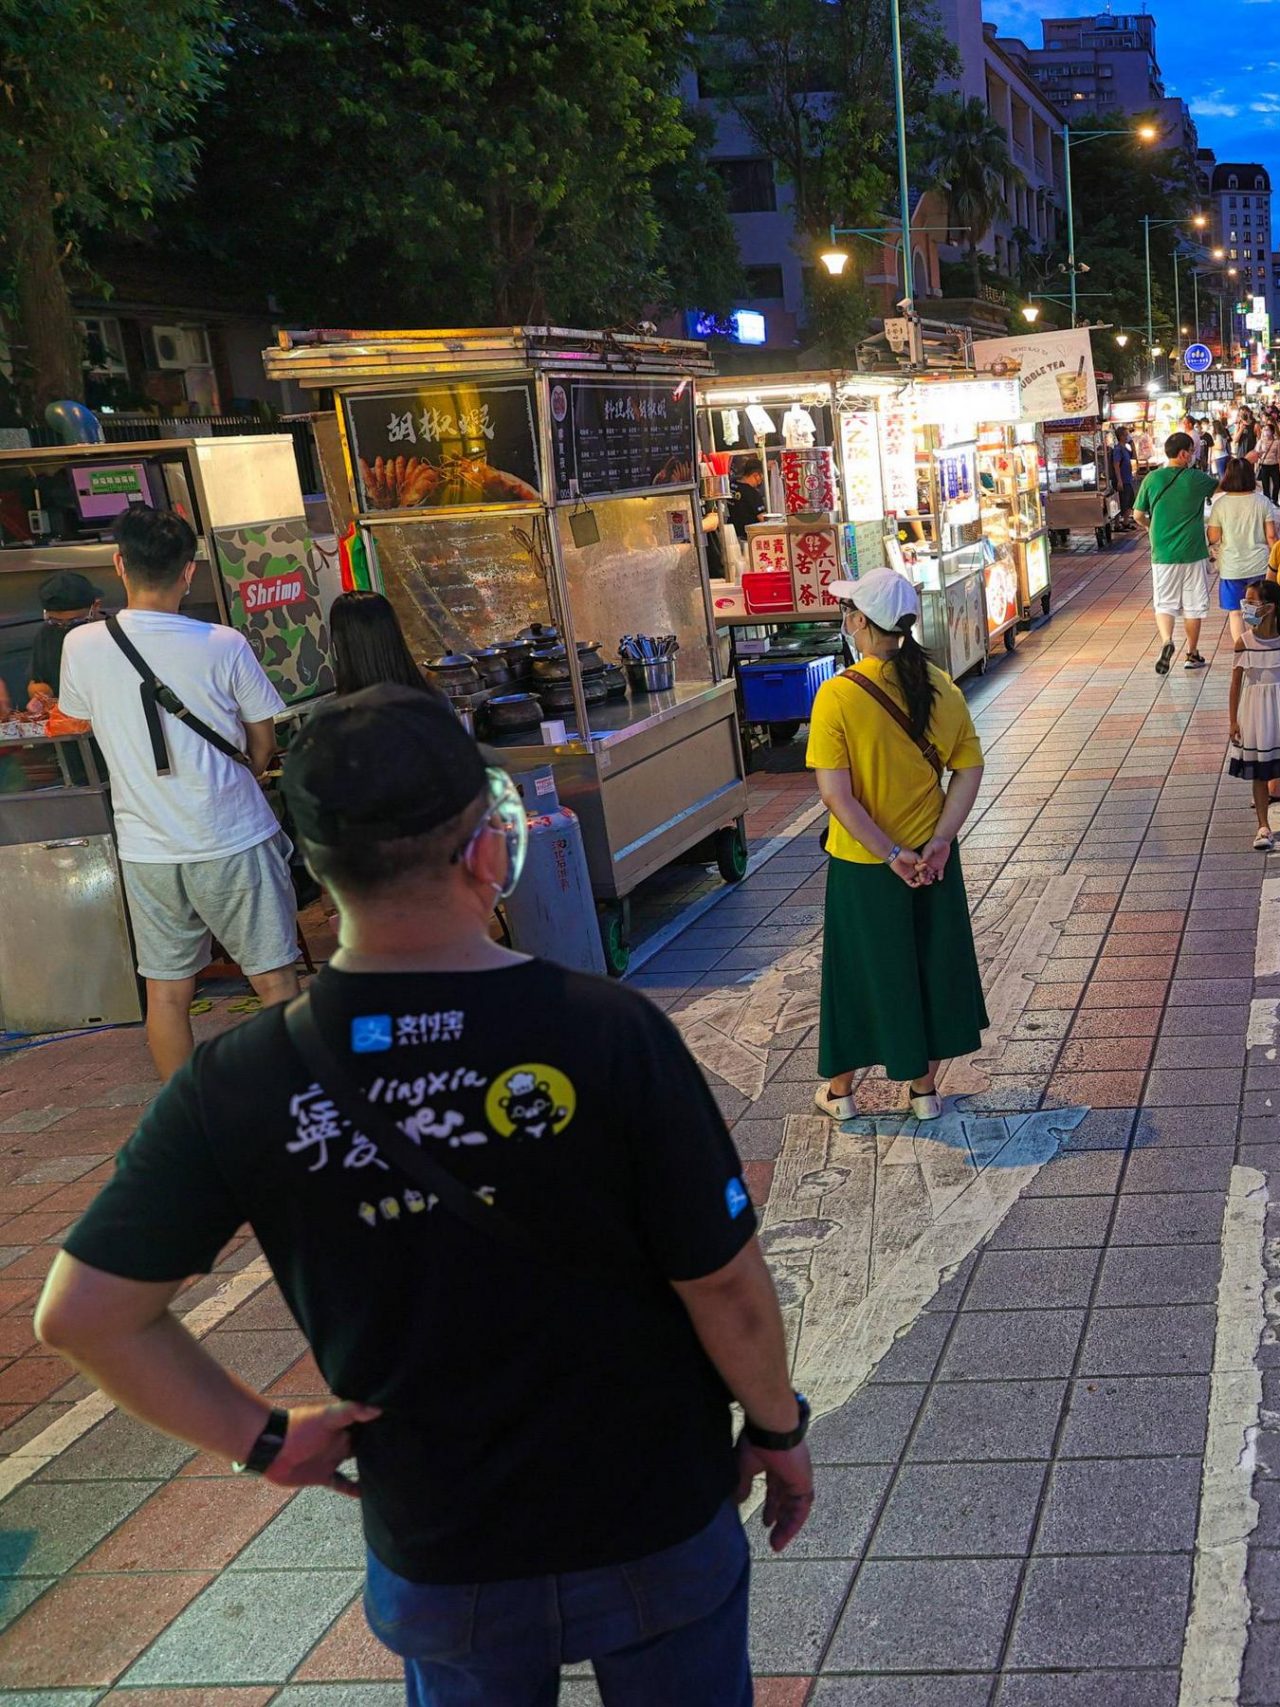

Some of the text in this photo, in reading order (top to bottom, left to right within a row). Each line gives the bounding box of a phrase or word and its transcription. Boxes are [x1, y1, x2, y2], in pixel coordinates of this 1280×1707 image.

[1020, 367, 1046, 392] UBBLE
[1046, 360, 1066, 372] TEA
[386, 403, 496, 444] 胡椒蝦
[246, 579, 300, 608] Shrimp
[795, 553, 818, 607] 苦茶
[396, 1010, 465, 1034] 支付宝
[398, 1032, 464, 1046] ALIPAY
